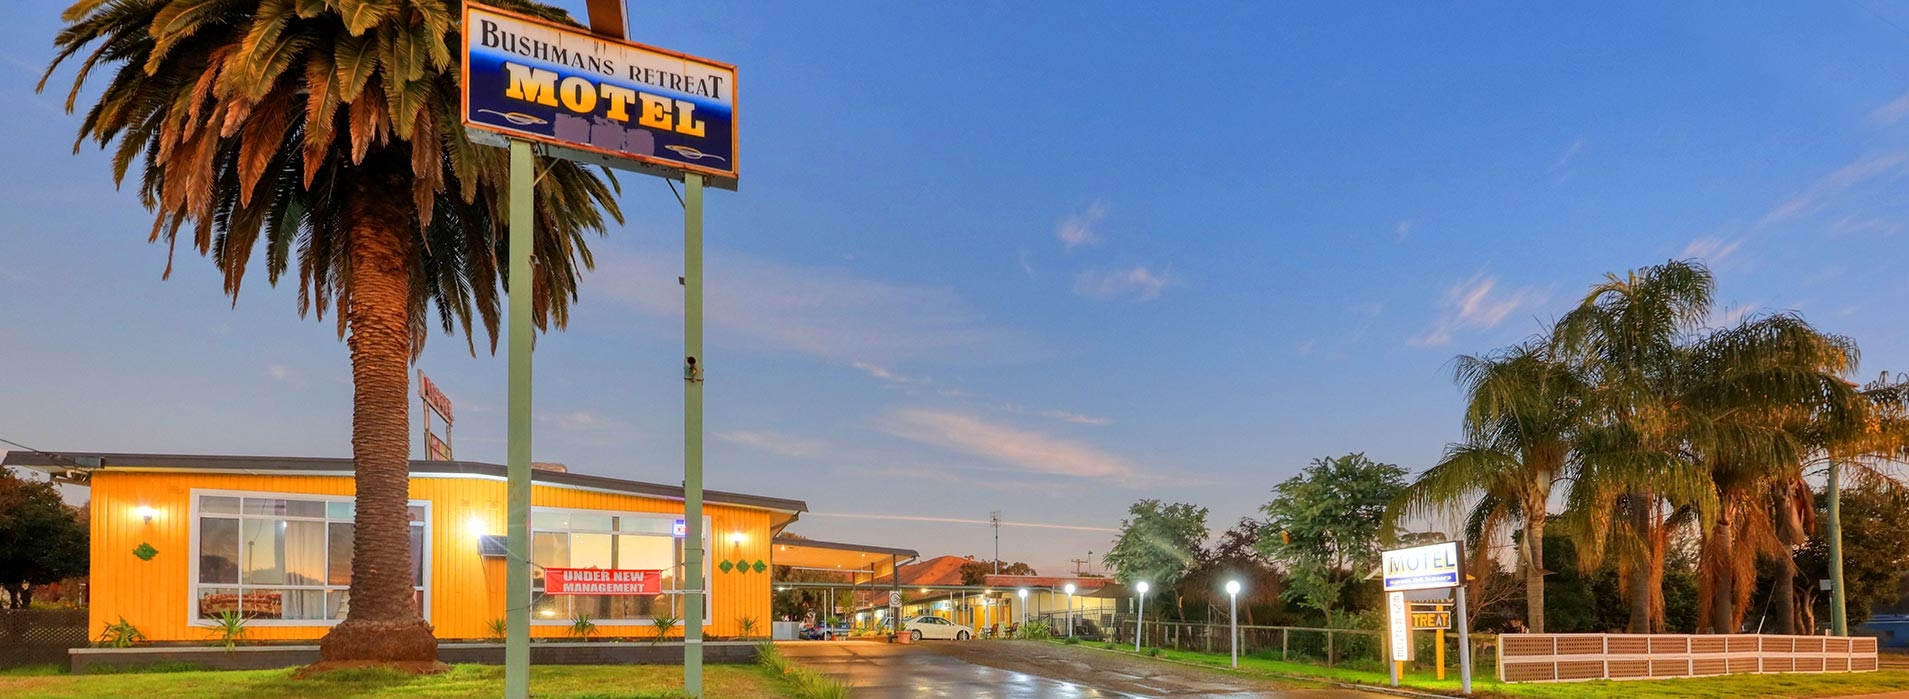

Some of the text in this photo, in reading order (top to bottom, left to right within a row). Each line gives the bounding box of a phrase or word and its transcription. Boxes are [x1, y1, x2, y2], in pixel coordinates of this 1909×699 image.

[480, 19, 723, 99] BUSHMANS RETREAT
[505, 61, 705, 138] MOTEL
[1388, 549, 1455, 575] MOTEL
[563, 570, 645, 582] UNDER NEW
[563, 583, 645, 593] MANAGEMENT
